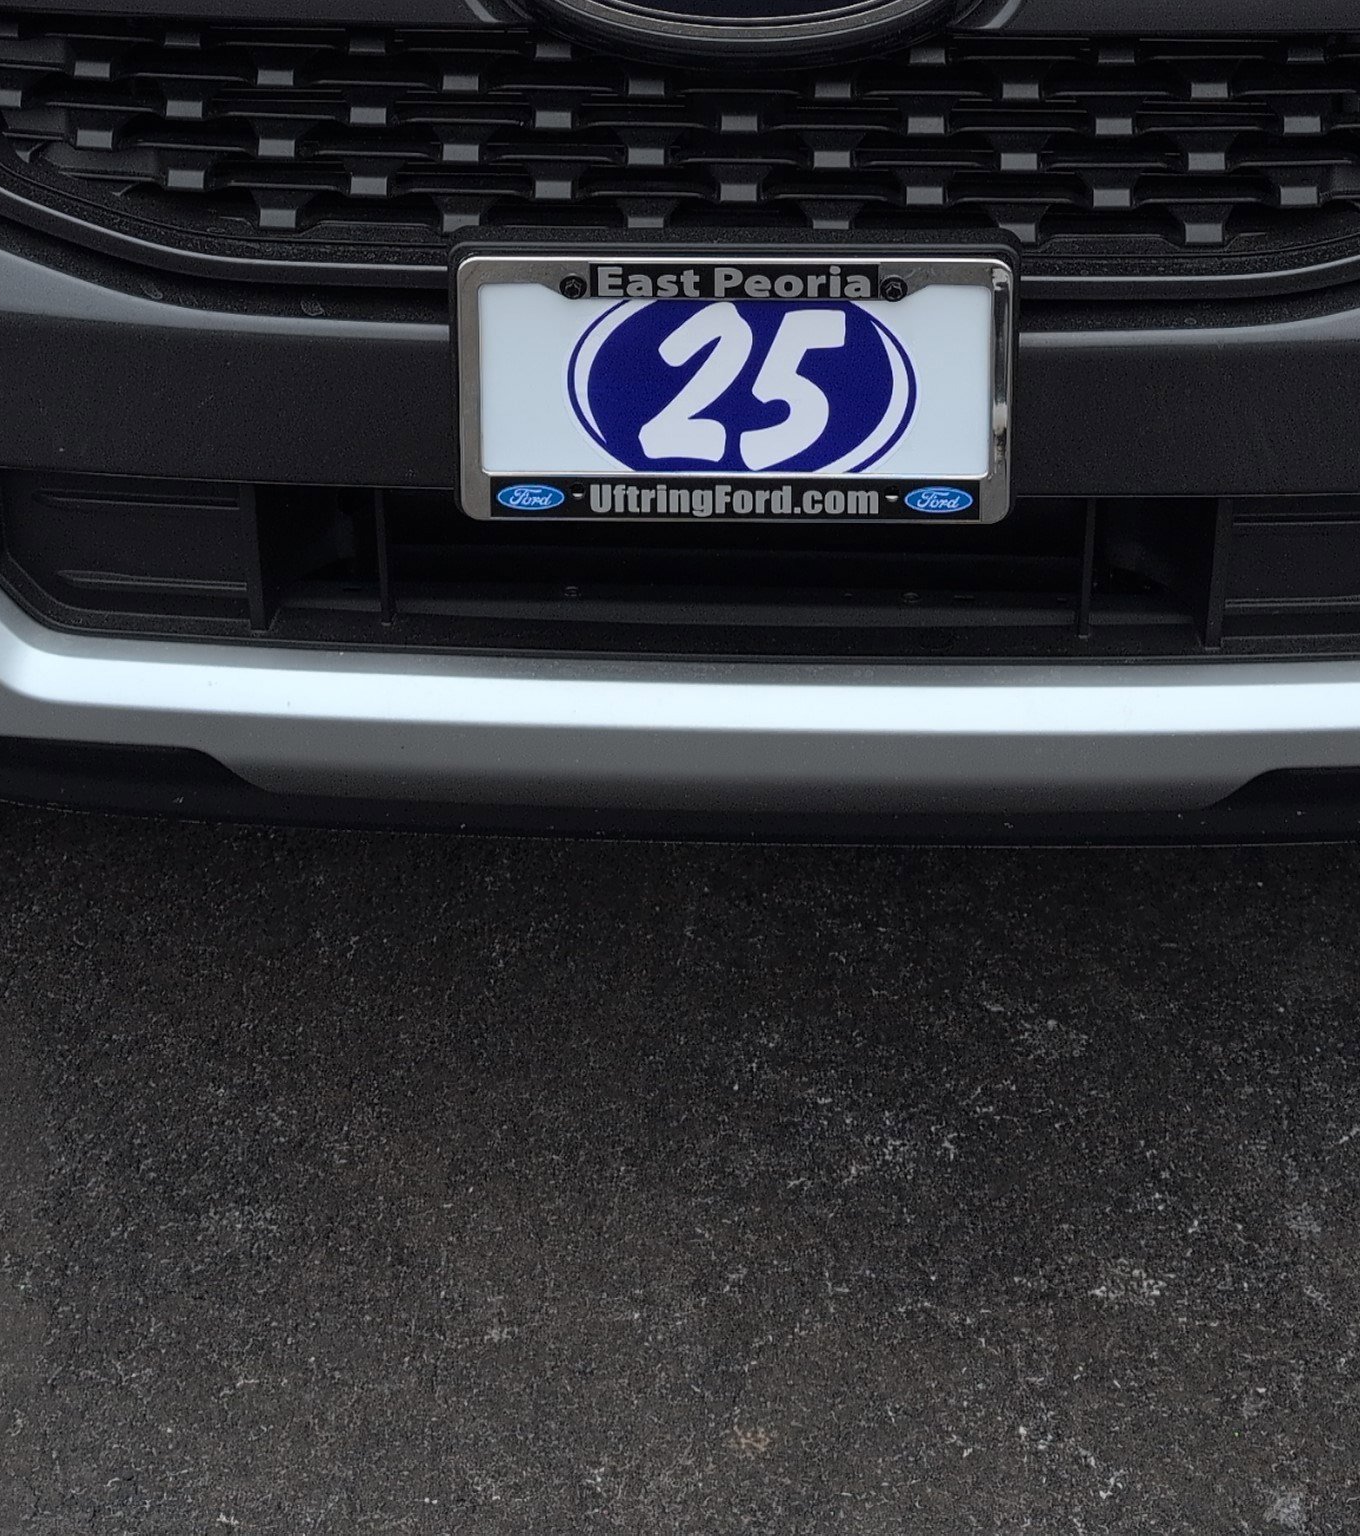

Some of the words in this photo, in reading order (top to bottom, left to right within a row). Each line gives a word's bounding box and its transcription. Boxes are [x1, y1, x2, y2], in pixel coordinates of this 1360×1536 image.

[597, 266, 700, 298] East
[713, 265, 871, 299] Peoria
[638, 301, 846, 472] 25
[509, 488, 553, 506] Ford
[589, 484, 880, 517] UftringFord.com
[916, 490, 961, 508] Ford
